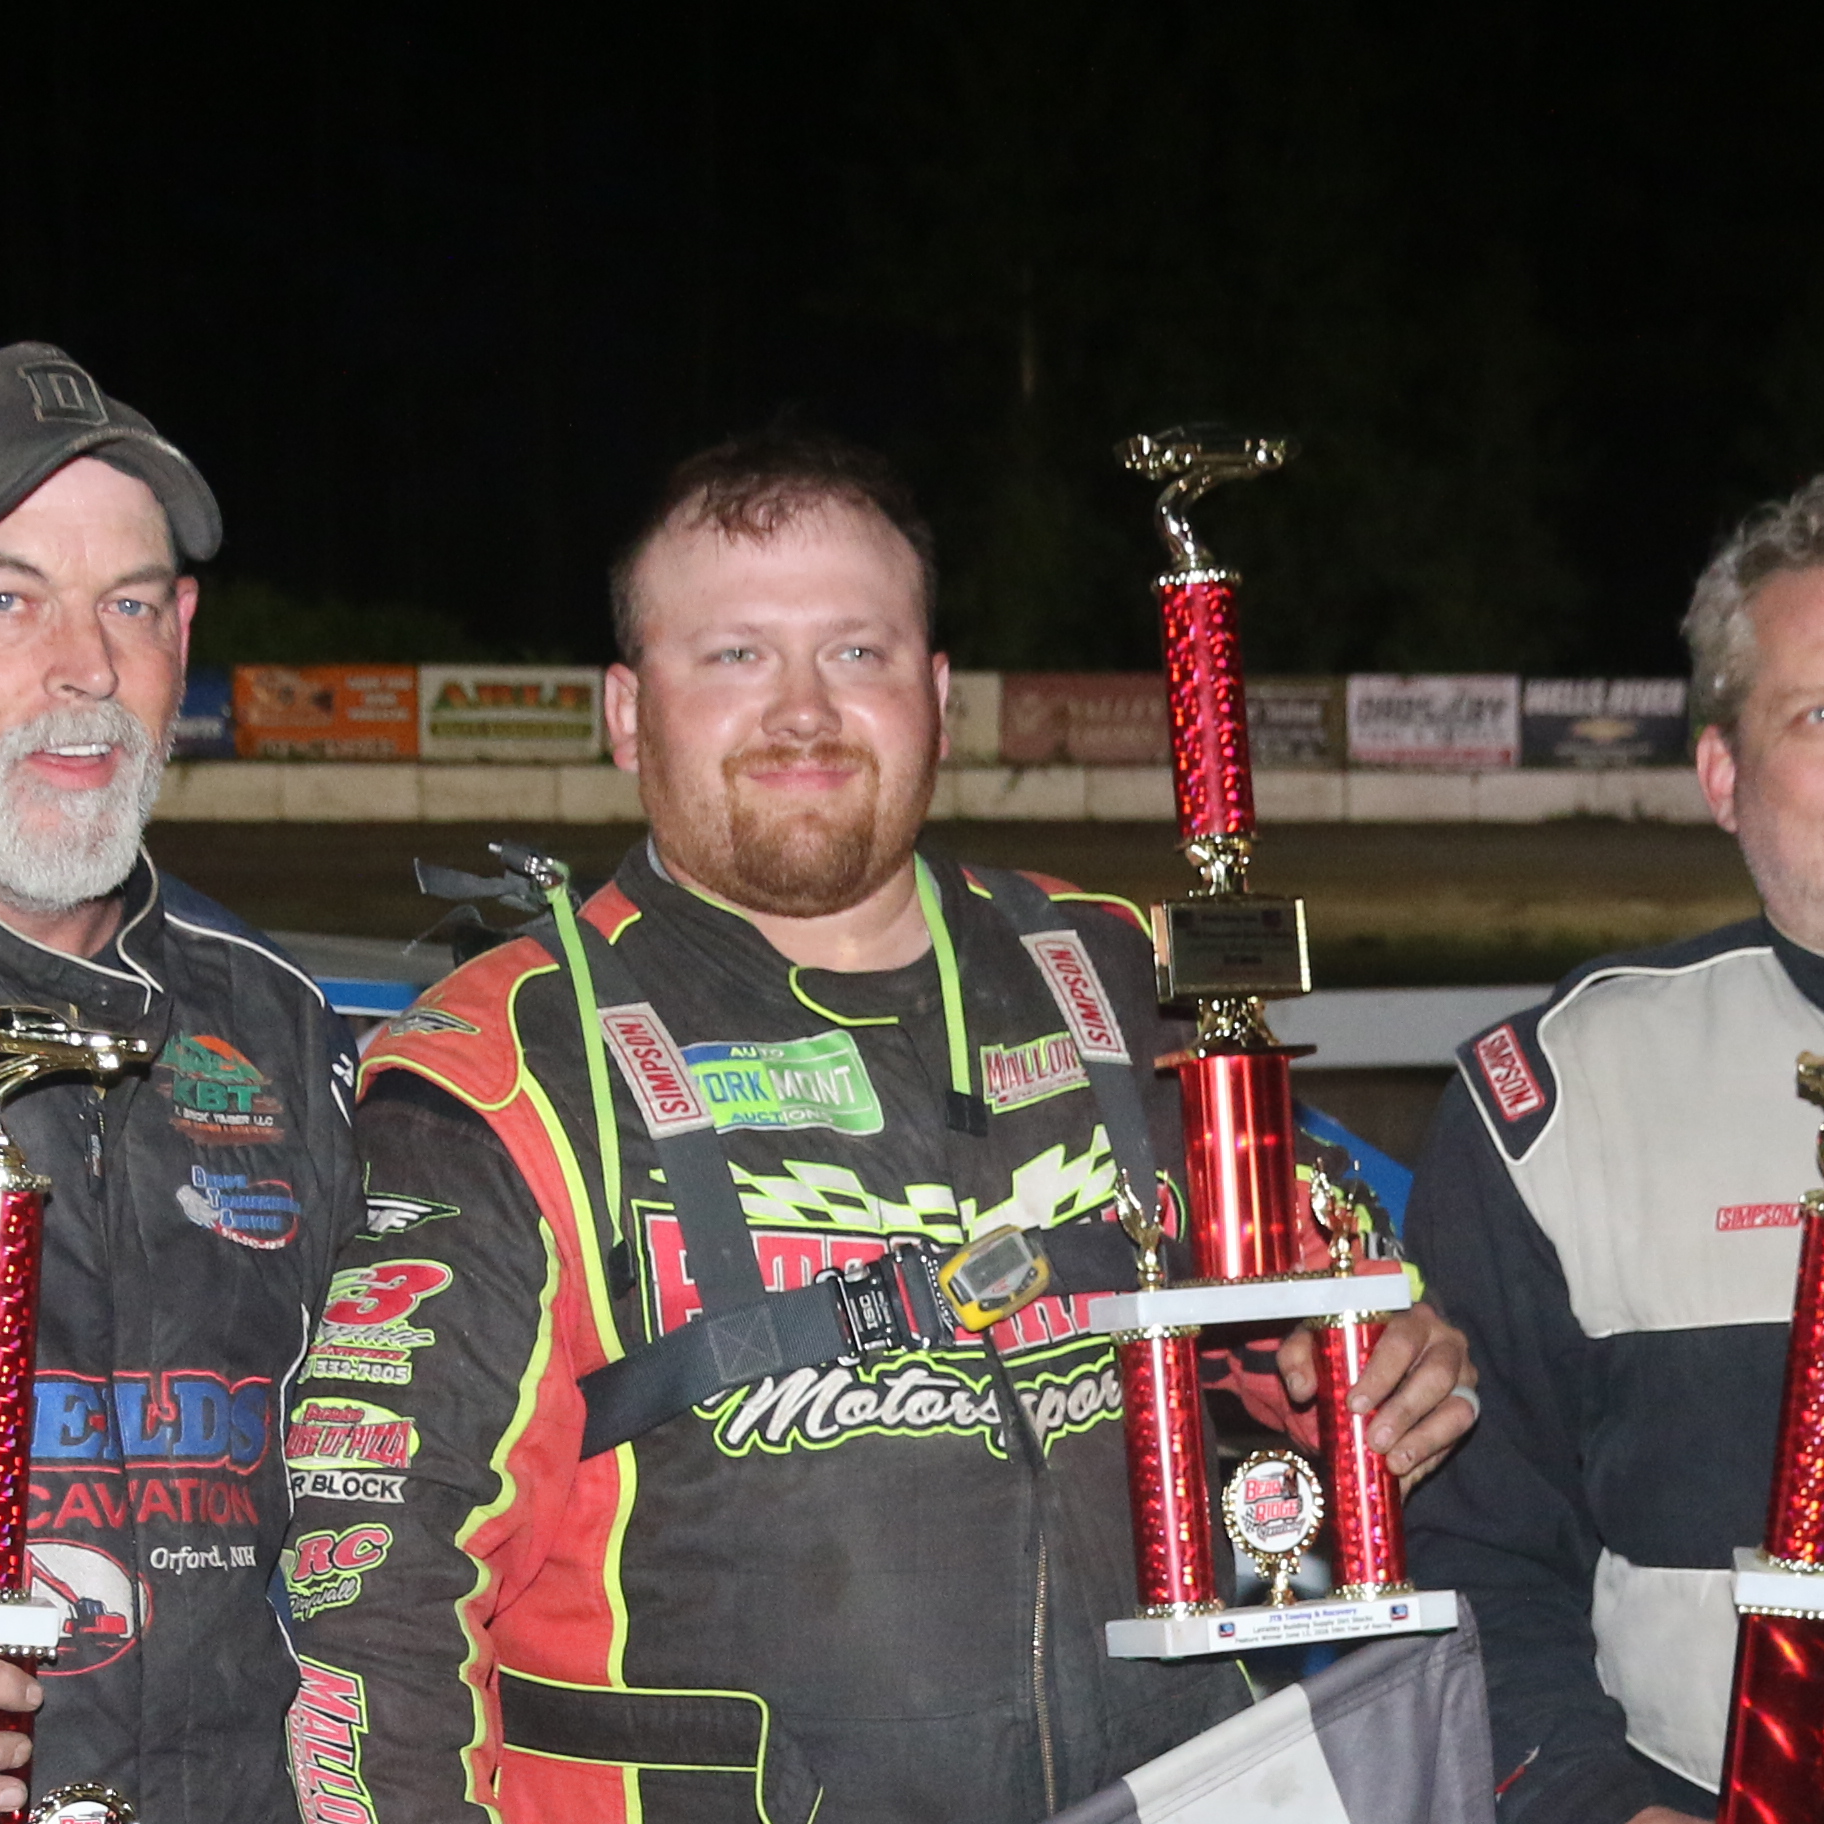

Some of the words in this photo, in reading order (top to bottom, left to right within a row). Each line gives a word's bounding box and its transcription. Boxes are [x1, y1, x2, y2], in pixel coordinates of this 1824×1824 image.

[1046, 945, 1113, 1046] SIMPSON
[615, 1020, 690, 1114] SIMPSON
[729, 1044, 785, 1060] AUTO
[985, 1037, 1080, 1094] MALLOR
[1479, 1030, 1540, 1111] SIMPSON
[730, 1107, 834, 1124] AUCTIONS
[310, 1474, 399, 1500] BLOCK
[150, 1546, 228, 1575] Orford,
[229, 1546, 257, 1568] NH
[293, 1528, 388, 1581] RC
